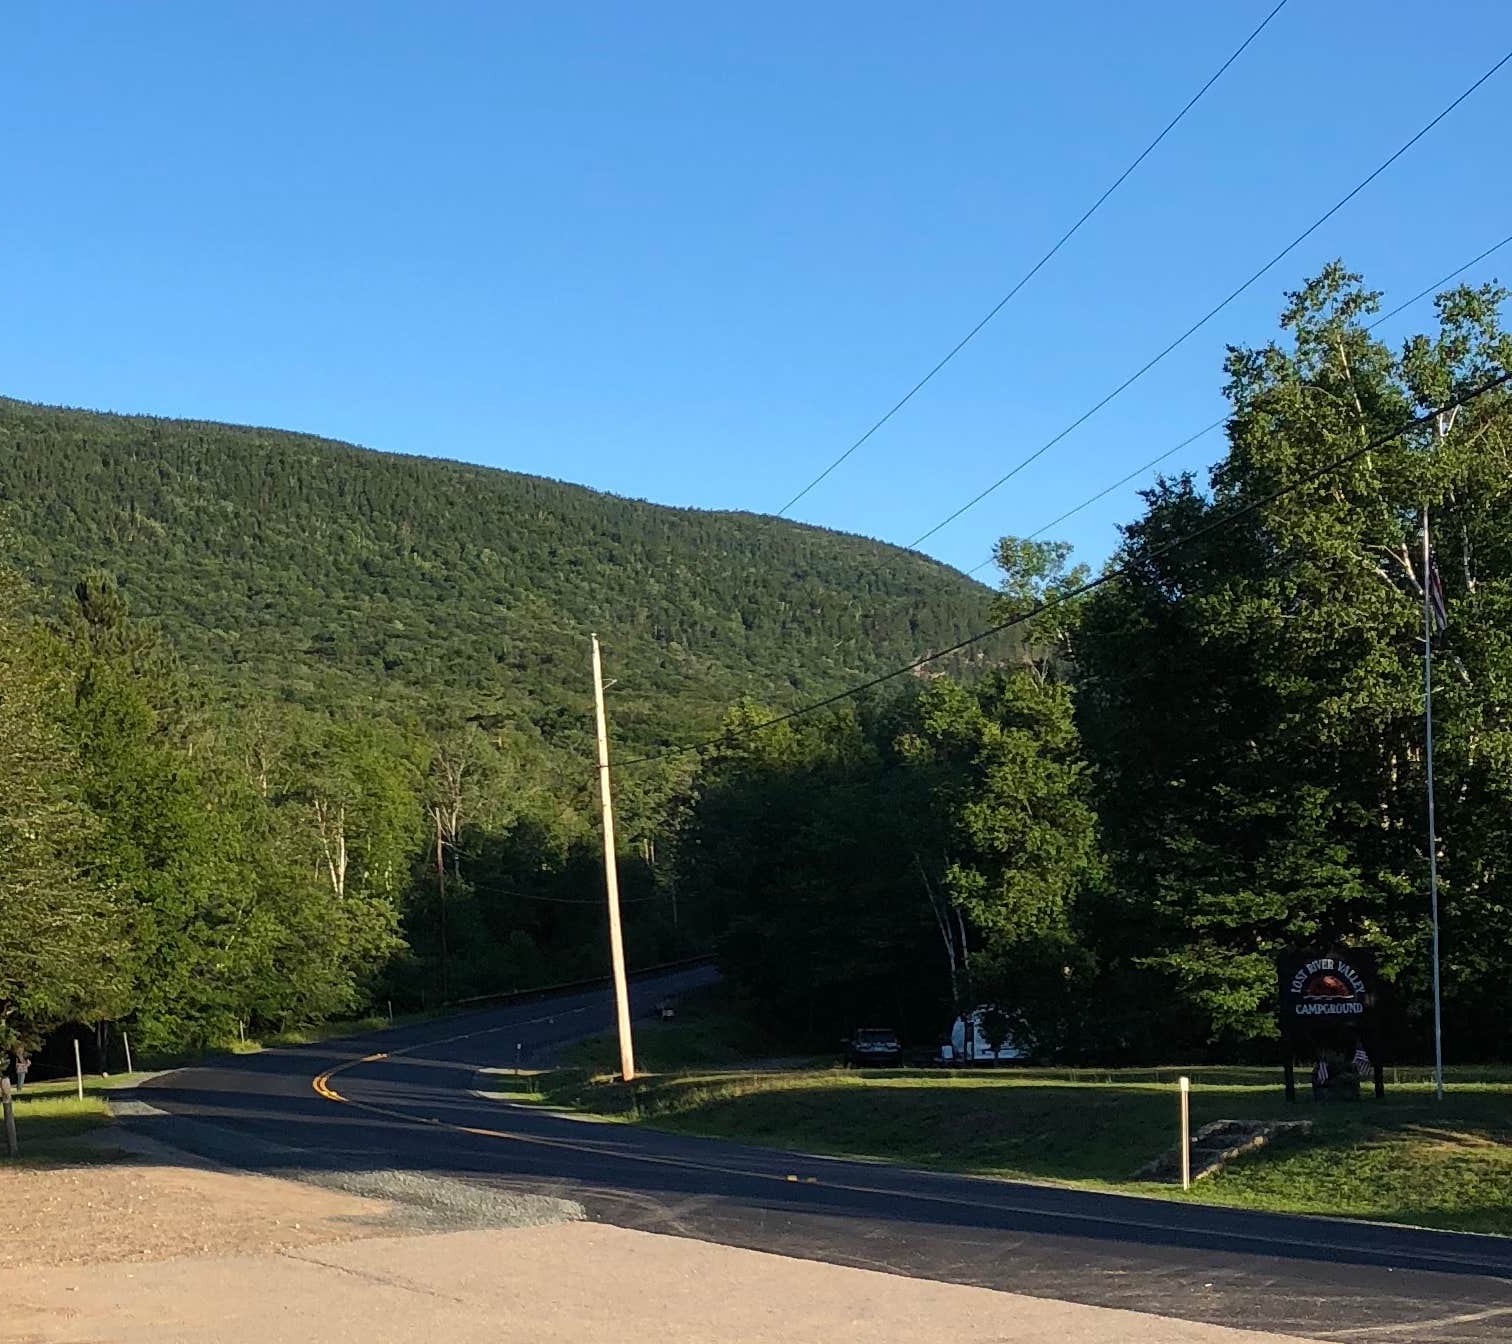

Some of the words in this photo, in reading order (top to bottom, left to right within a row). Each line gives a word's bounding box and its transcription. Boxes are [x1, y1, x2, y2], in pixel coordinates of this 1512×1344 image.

[1291, 969, 1308, 993] LOST
[1306, 959, 1334, 974] RIVER
[1337, 961, 1366, 993] VALLEY
[1296, 1002, 1363, 1015] CAMPGROUND
